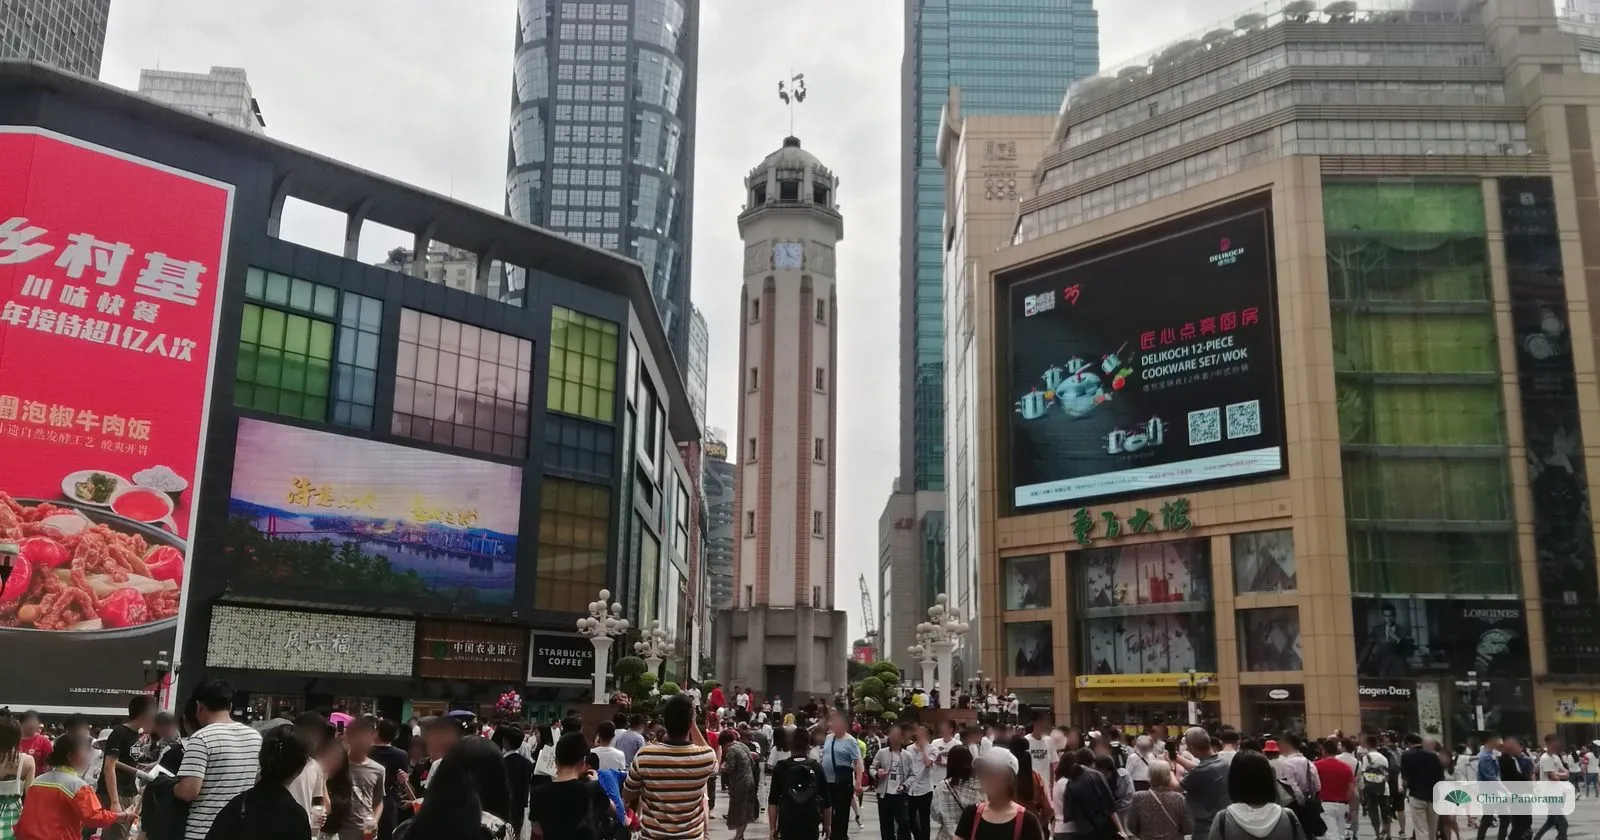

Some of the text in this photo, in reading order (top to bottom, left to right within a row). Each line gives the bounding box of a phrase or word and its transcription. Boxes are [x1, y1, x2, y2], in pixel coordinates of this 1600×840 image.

[0, 217, 207, 305] 乡村基
[1210, 247, 1244, 262] DELIKOCH
[21, 275, 160, 323] 川味快餐
[0, 301, 196, 361] 年接待超1亿人次
[1140, 307, 1259, 350] 匠心点亮厨房
[1141, 335, 1234, 366] DELIKOCH 12-PIECE
[1142, 359, 1197, 380] COOKWARE
[1222, 347, 1248, 362] WOK
[1463, 608, 1519, 618] LONGINES
[284, 630, 350, 654] 周六福
[453, 642, 517, 657] 中国农业银行
[538, 648, 593, 659] STARBUCKS
[548, 658, 582, 667] COFFEE
[1359, 685, 1411, 697] äagen-Dazs
